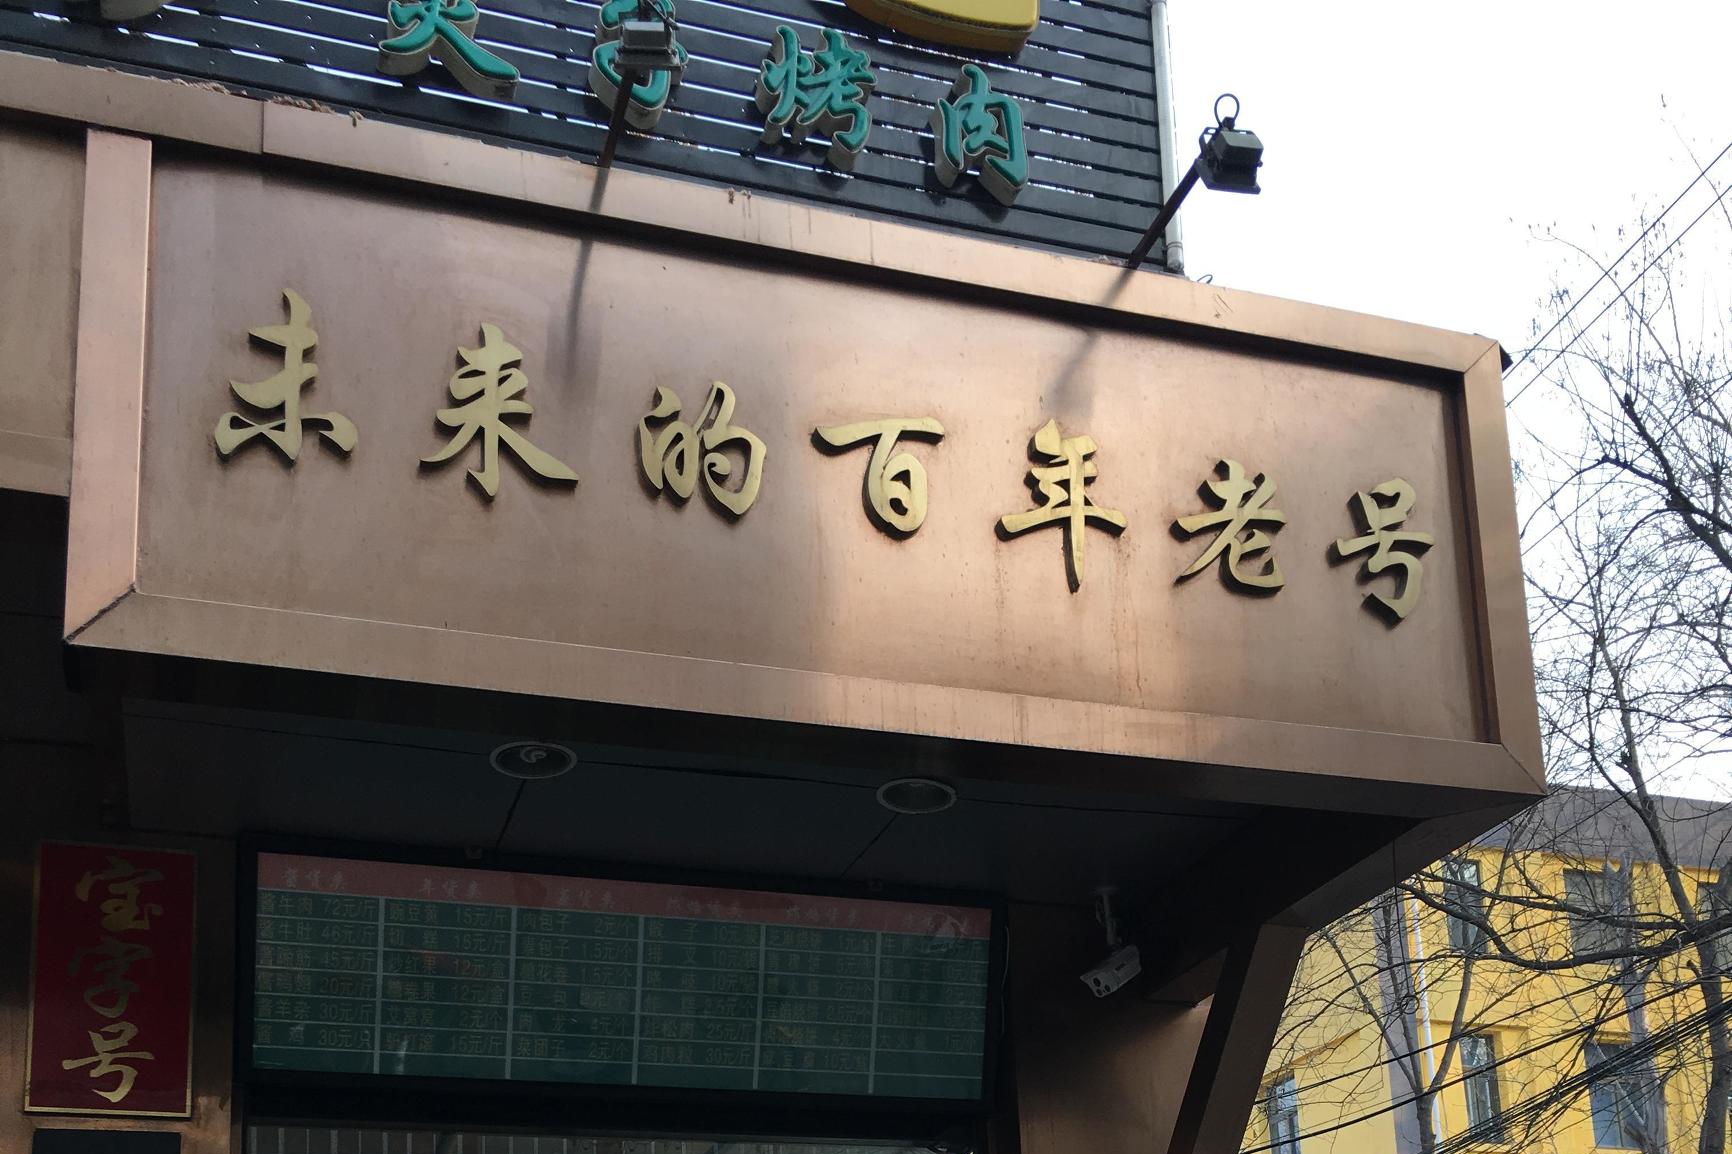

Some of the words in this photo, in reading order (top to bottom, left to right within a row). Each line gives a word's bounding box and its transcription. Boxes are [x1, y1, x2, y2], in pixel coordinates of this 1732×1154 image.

[214, 287, 1435, 620] 未来的百年老号
